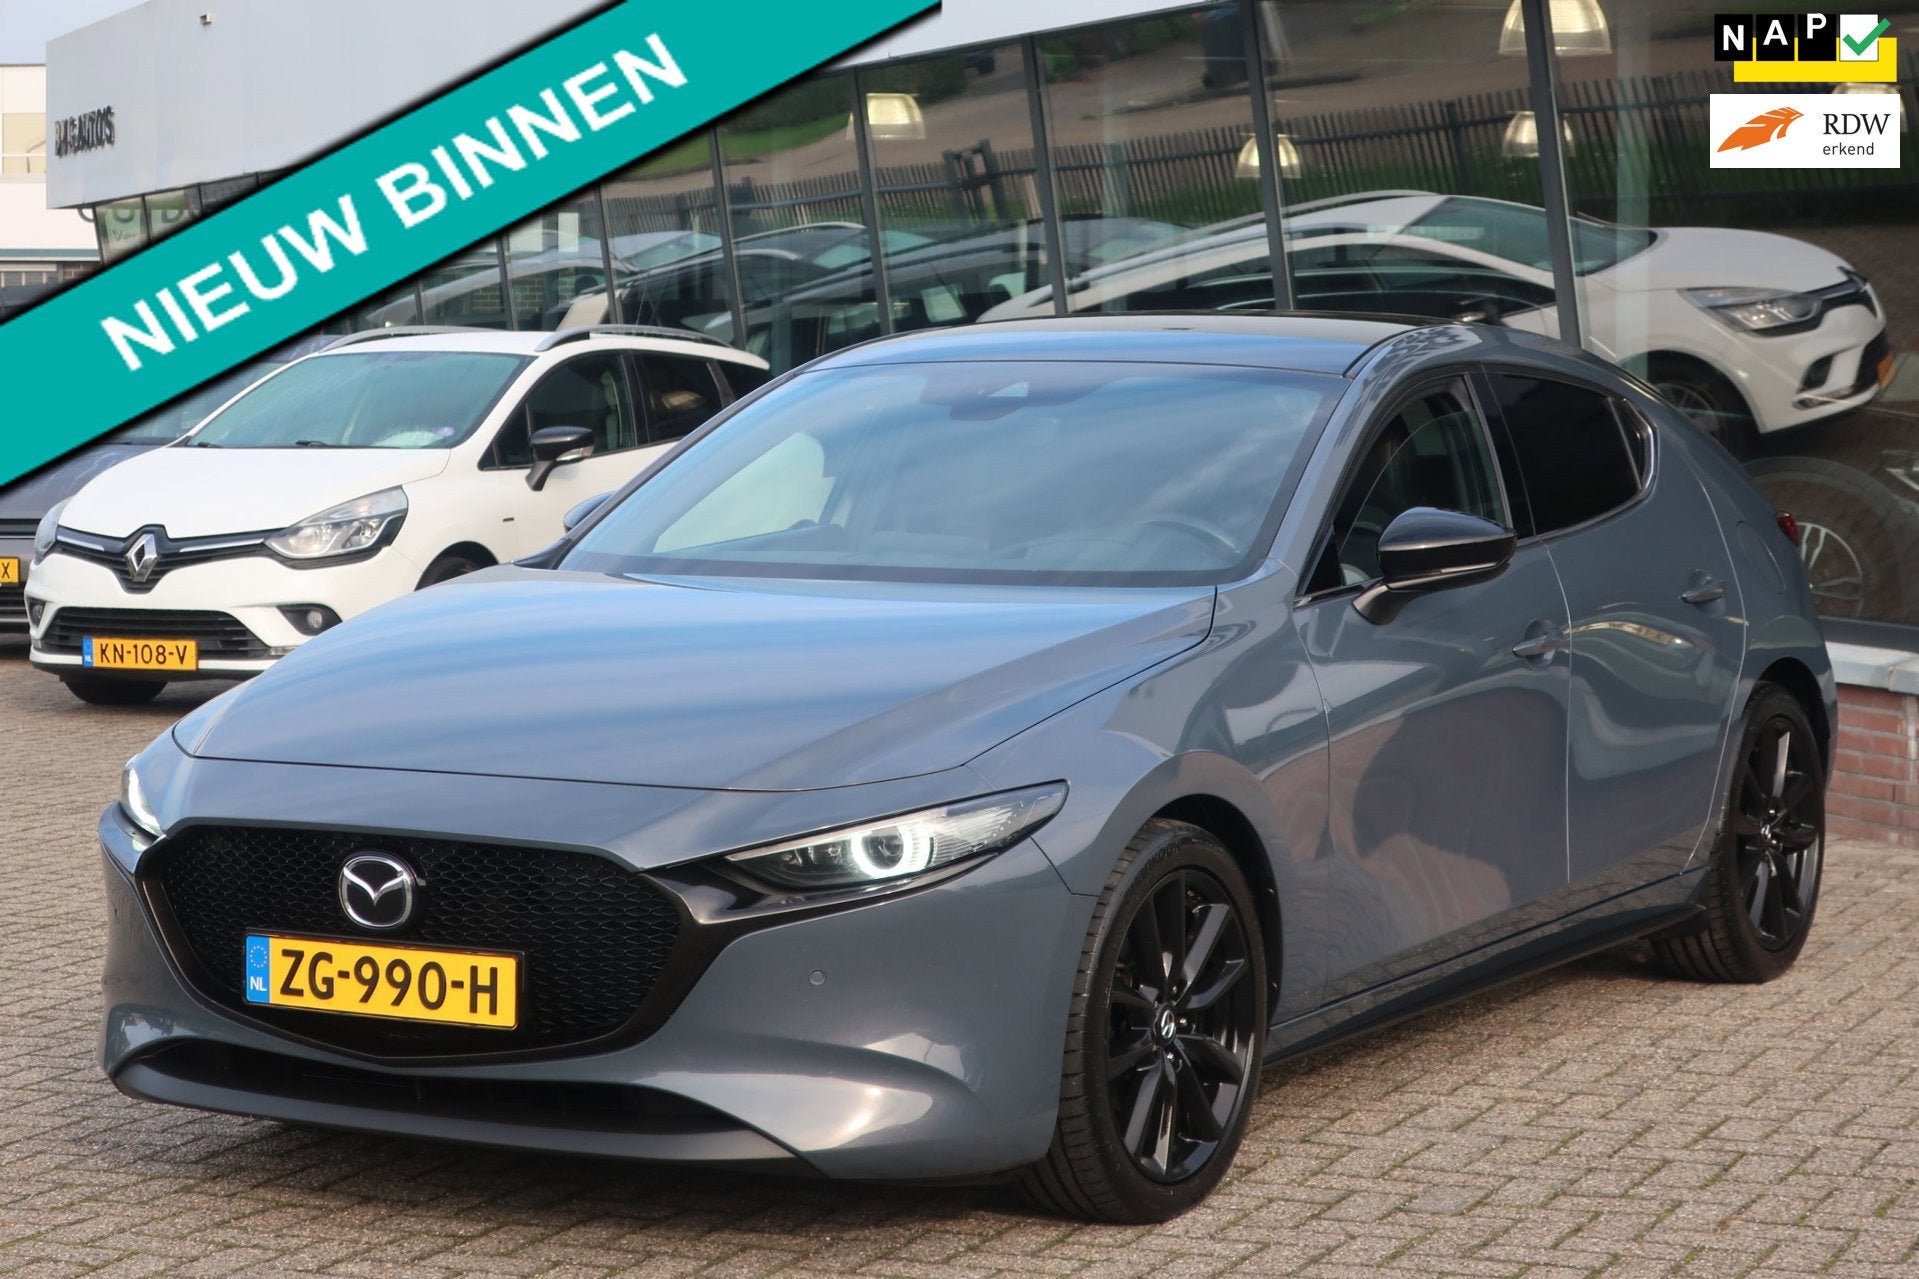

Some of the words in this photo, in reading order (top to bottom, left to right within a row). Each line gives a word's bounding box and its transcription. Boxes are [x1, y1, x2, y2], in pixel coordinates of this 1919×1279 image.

[100, 643, 187, 665] KN-108-V
[250, 975, 267, 992] NL
[279, 948, 498, 1016] ZG-990-H
